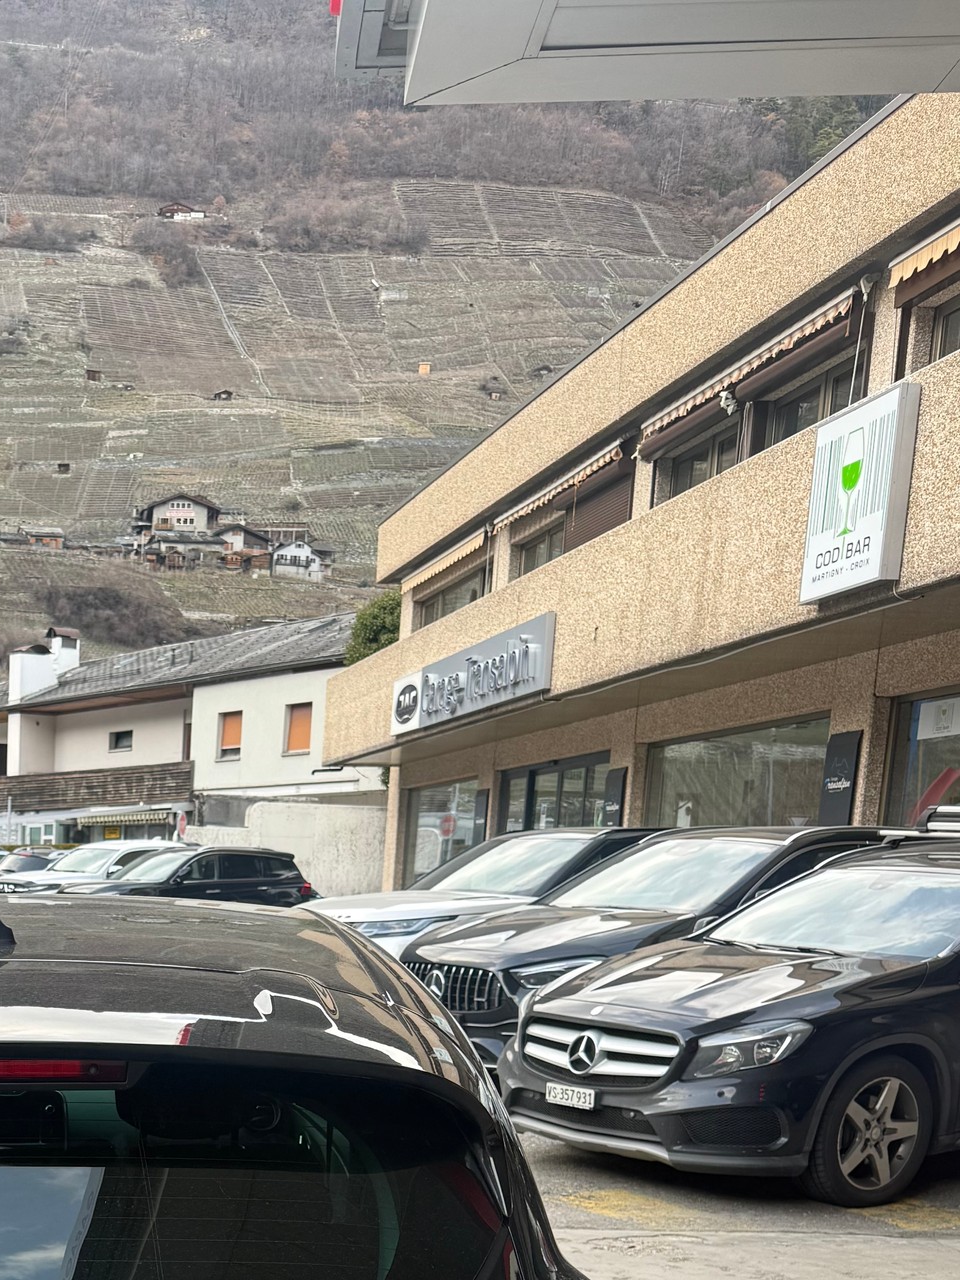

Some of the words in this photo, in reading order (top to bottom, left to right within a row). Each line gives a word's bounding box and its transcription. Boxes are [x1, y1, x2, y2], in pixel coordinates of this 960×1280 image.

[812, 567, 843, 583] MARTIGNY
[850, 558, 870, 571] CROIX
[421, 673, 464, 715] Garage
